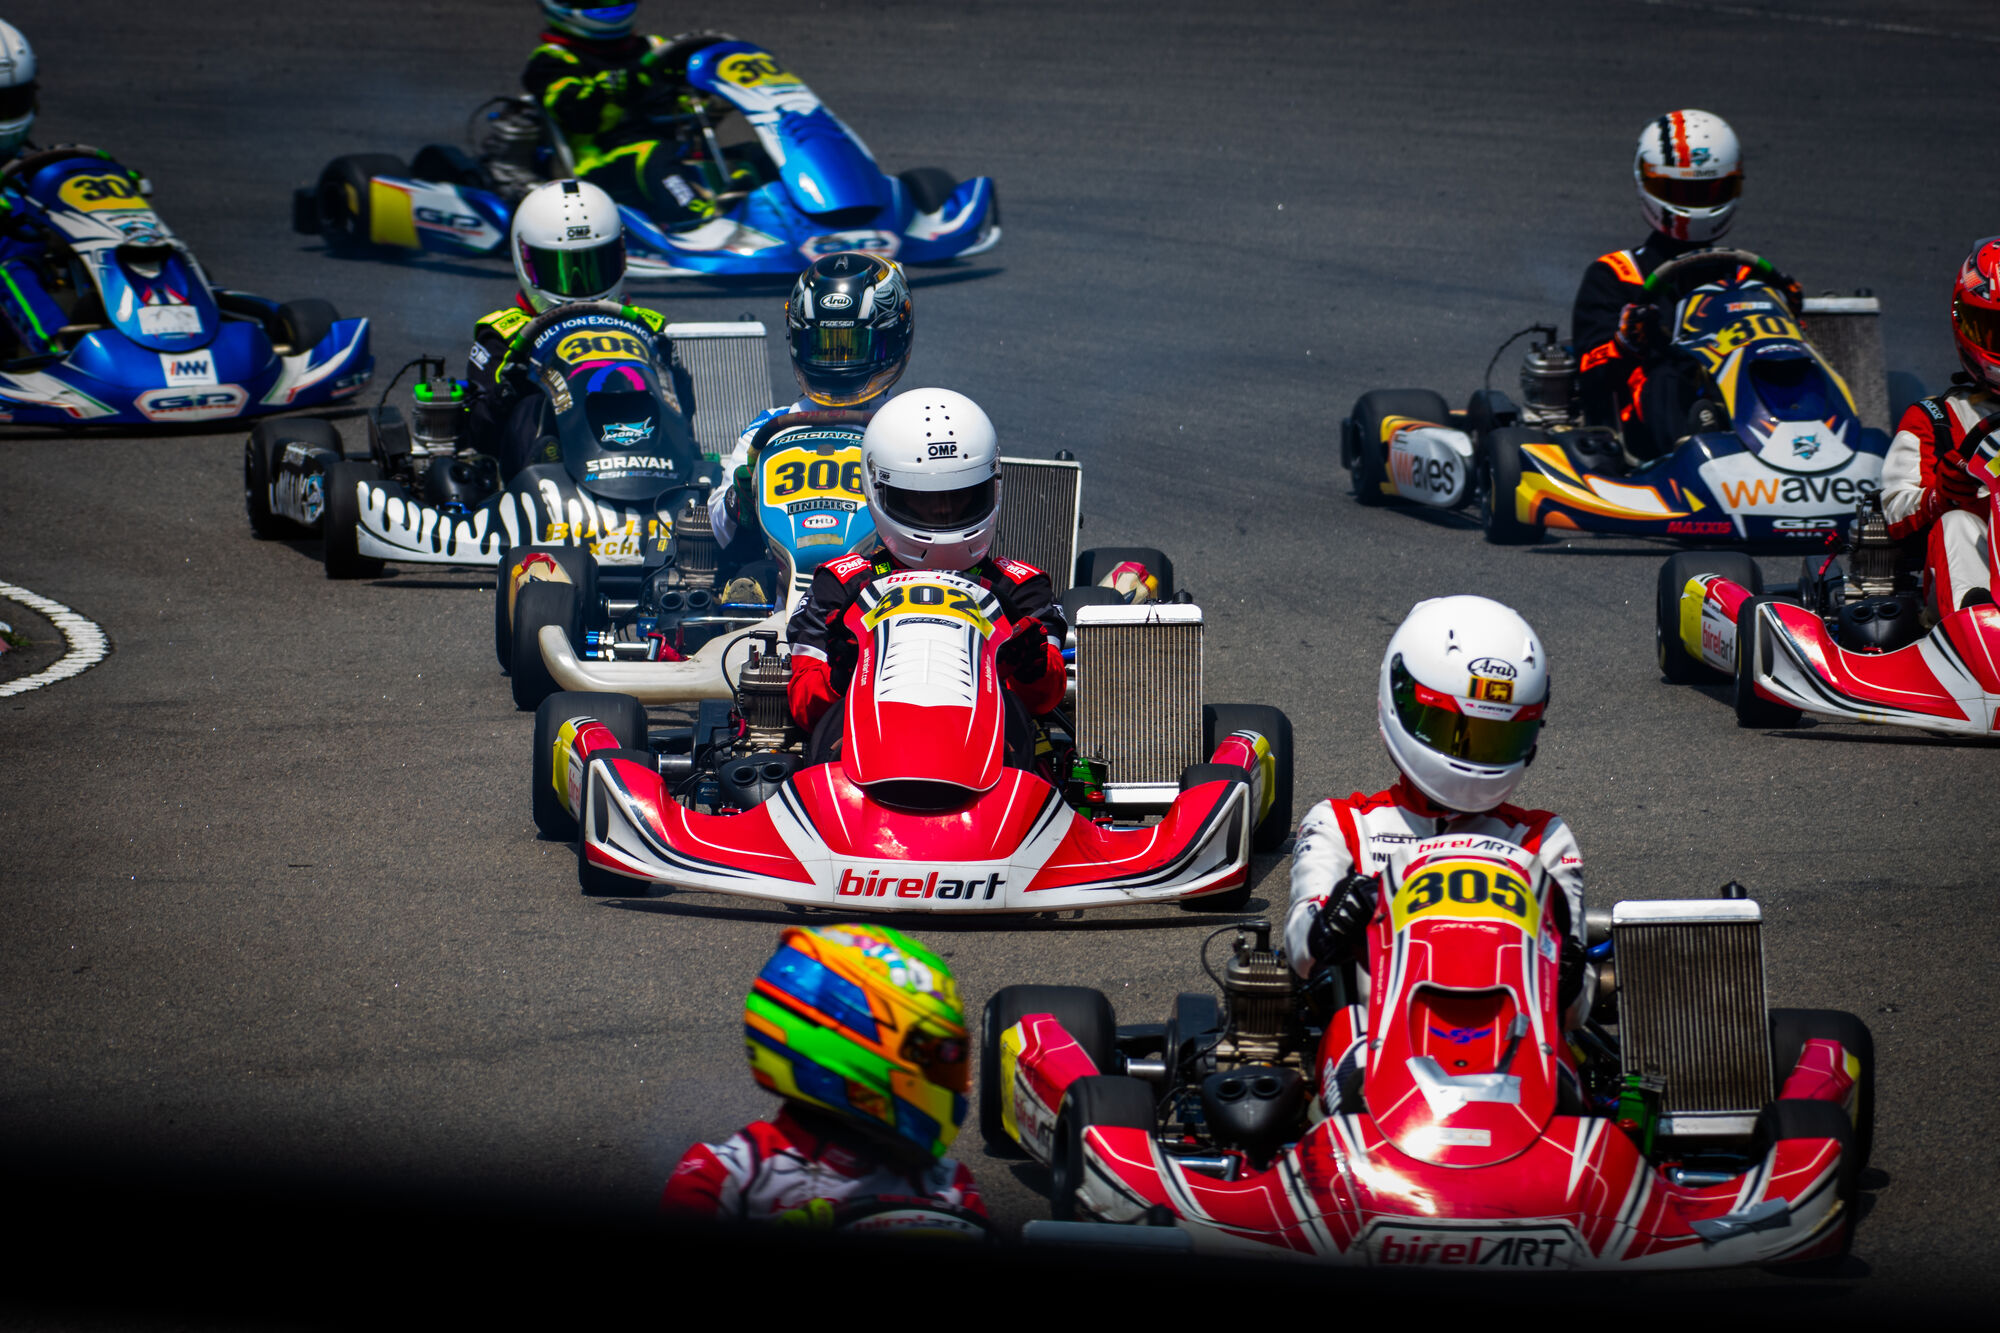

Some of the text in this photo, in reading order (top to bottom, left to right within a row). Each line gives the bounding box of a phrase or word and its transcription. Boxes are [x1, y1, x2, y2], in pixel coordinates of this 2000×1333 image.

[566, 227, 591, 239] OMP
[823, 295, 849, 306] Arai
[563, 336, 649, 363] 308
[928, 445, 957, 457] OMP
[586, 456, 674, 472] SORAYAH
[774, 459, 863, 497] 306
[1667, 521, 1733, 534] MAXXIS
[836, 558, 866, 574] OMP
[874, 585, 980, 624] 302
[1479, 659, 1513, 678] Arai
[836, 868, 1006, 900] birelart
[1406, 868, 1527, 918] 305
[1379, 1234, 1566, 1267] birelART
